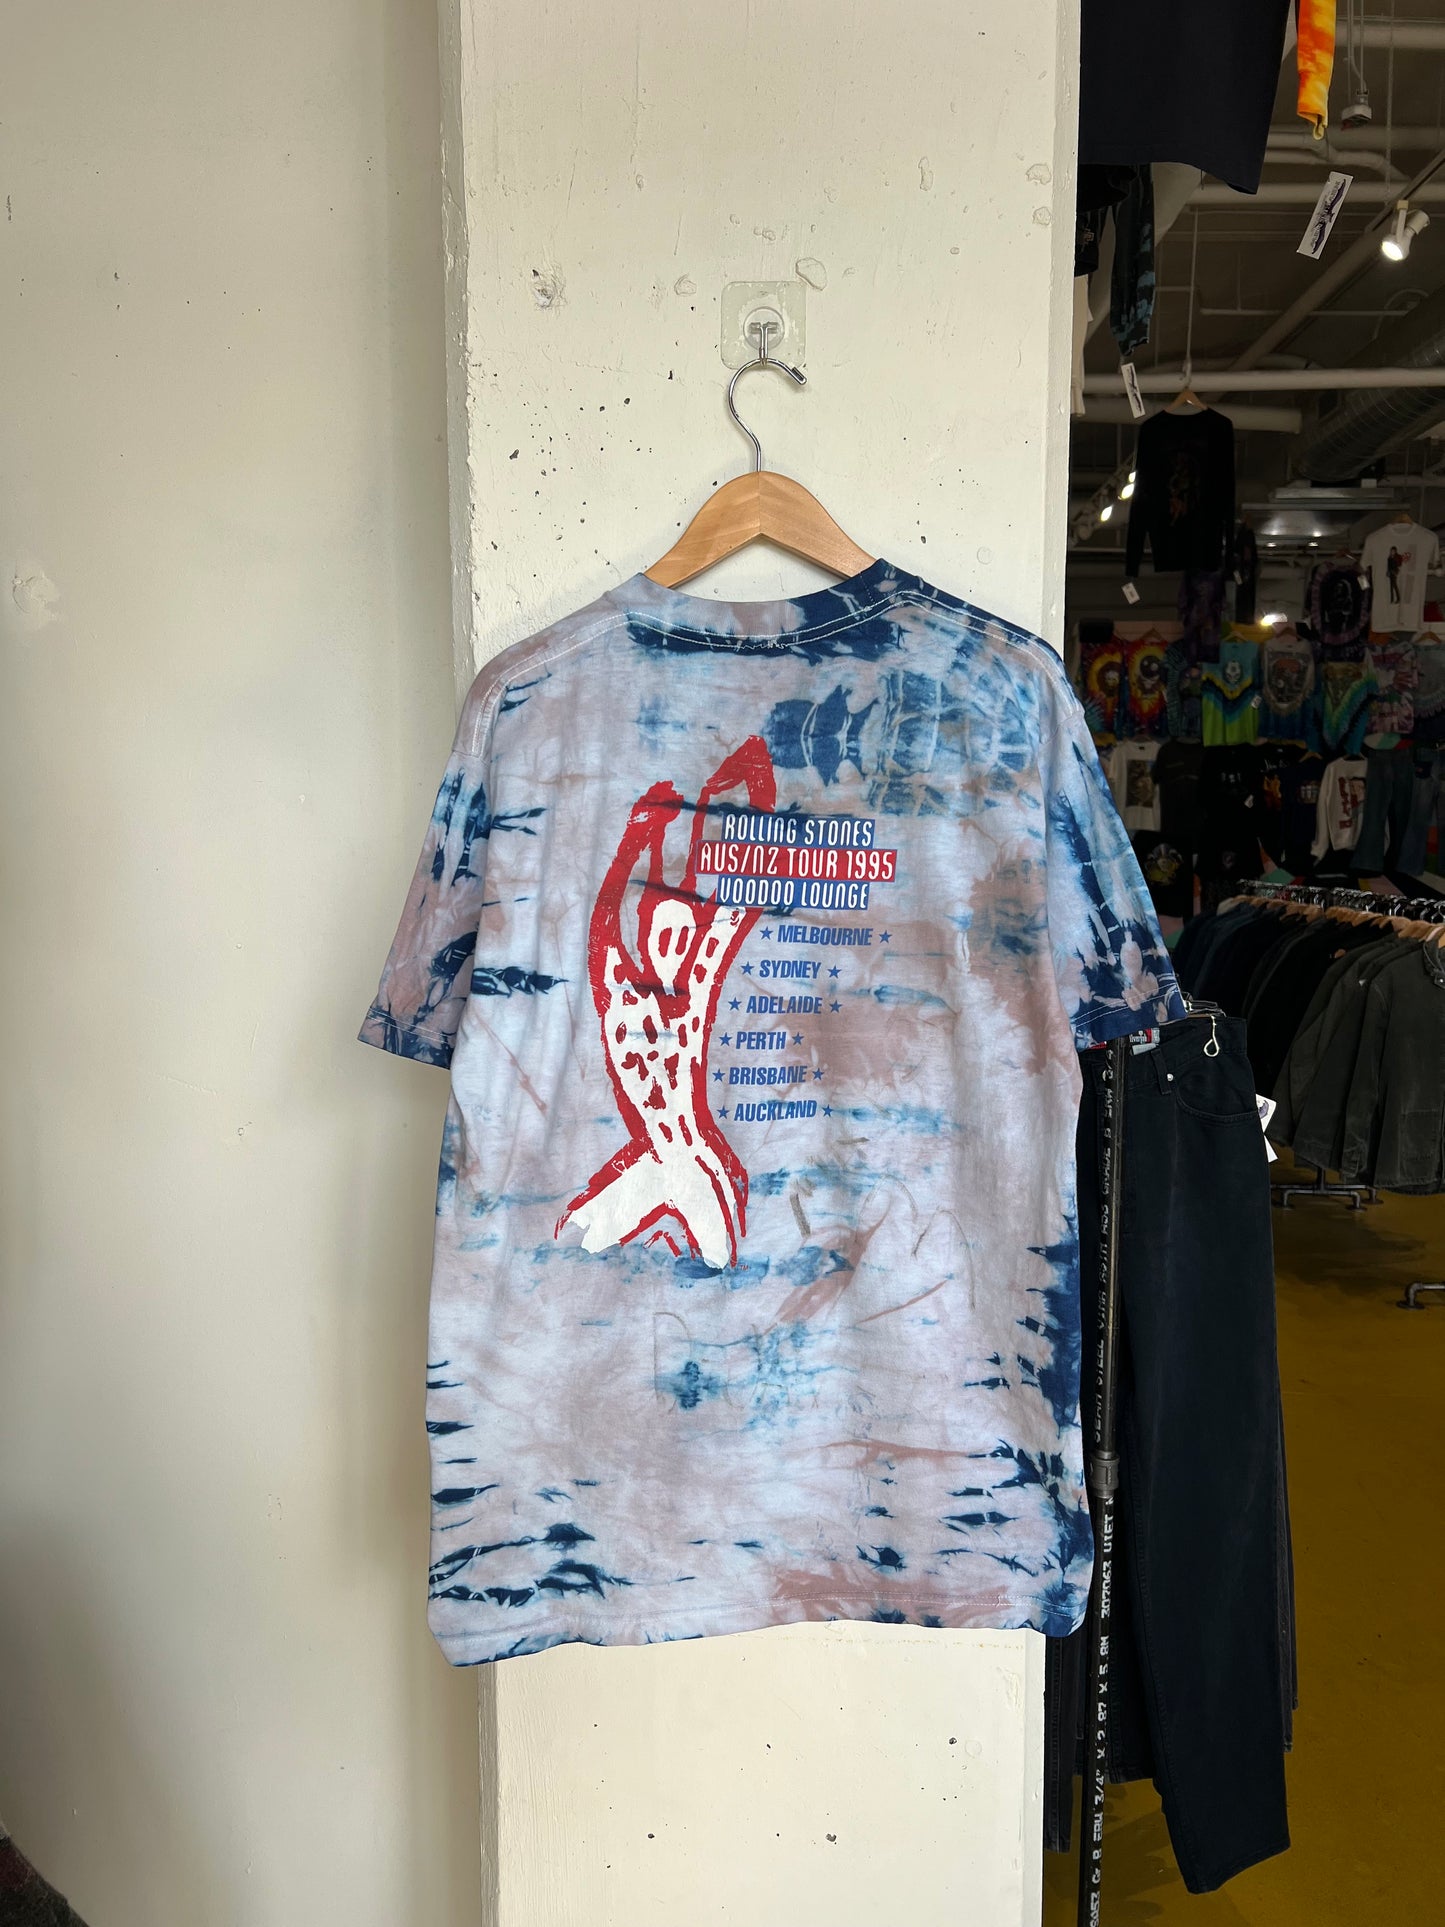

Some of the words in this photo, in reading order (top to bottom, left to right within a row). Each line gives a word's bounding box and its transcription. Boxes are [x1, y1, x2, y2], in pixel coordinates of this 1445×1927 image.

[724, 813, 797, 844] ROLLING
[804, 818, 874, 847] STONES
[700, 842, 779, 875] AUS/NZ
[786, 847, 838, 878] TOUR
[846, 850, 894, 880] 1995
[719, 876, 795, 906] VOODOO
[801, 881, 869, 909] LOUNGE
[777, 924, 874, 946] MELBOURNE
[759, 959, 822, 979] SYDNEY
[746, 995, 823, 1014] ADELAIDE
[735, 1031, 787, 1050] PERTH
[728, 1066, 809, 1085] BRISBANE
[734, 1100, 818, 1121] AUCKLAND
